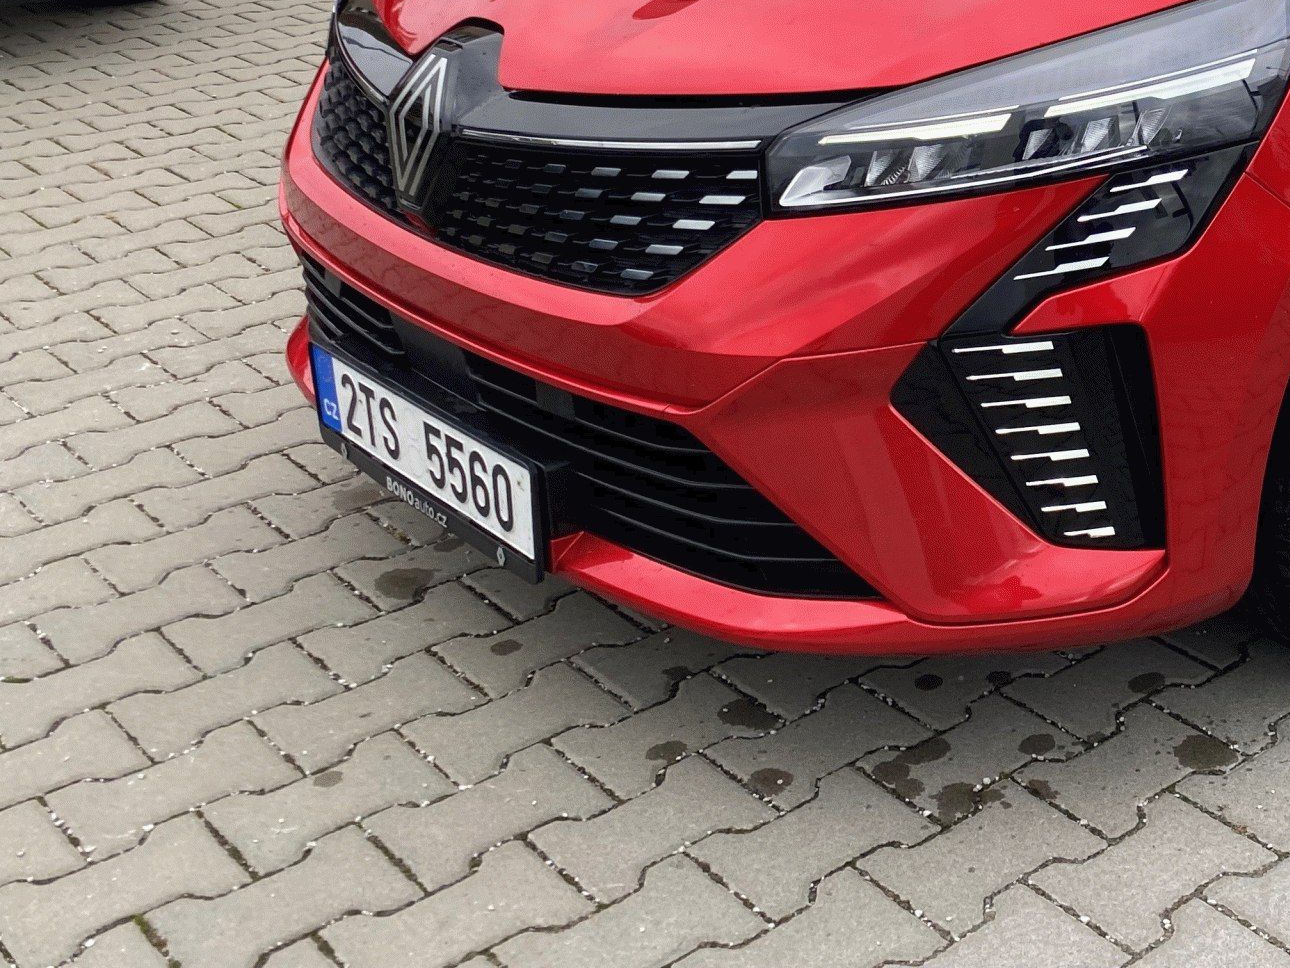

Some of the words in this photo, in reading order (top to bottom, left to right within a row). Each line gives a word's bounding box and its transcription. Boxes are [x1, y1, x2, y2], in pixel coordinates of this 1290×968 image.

[323, 398, 340, 421] CZ
[341, 373, 401, 461] 2TS
[422, 420, 514, 533] 5560
[386, 476, 448, 528] BONOauto.cz
